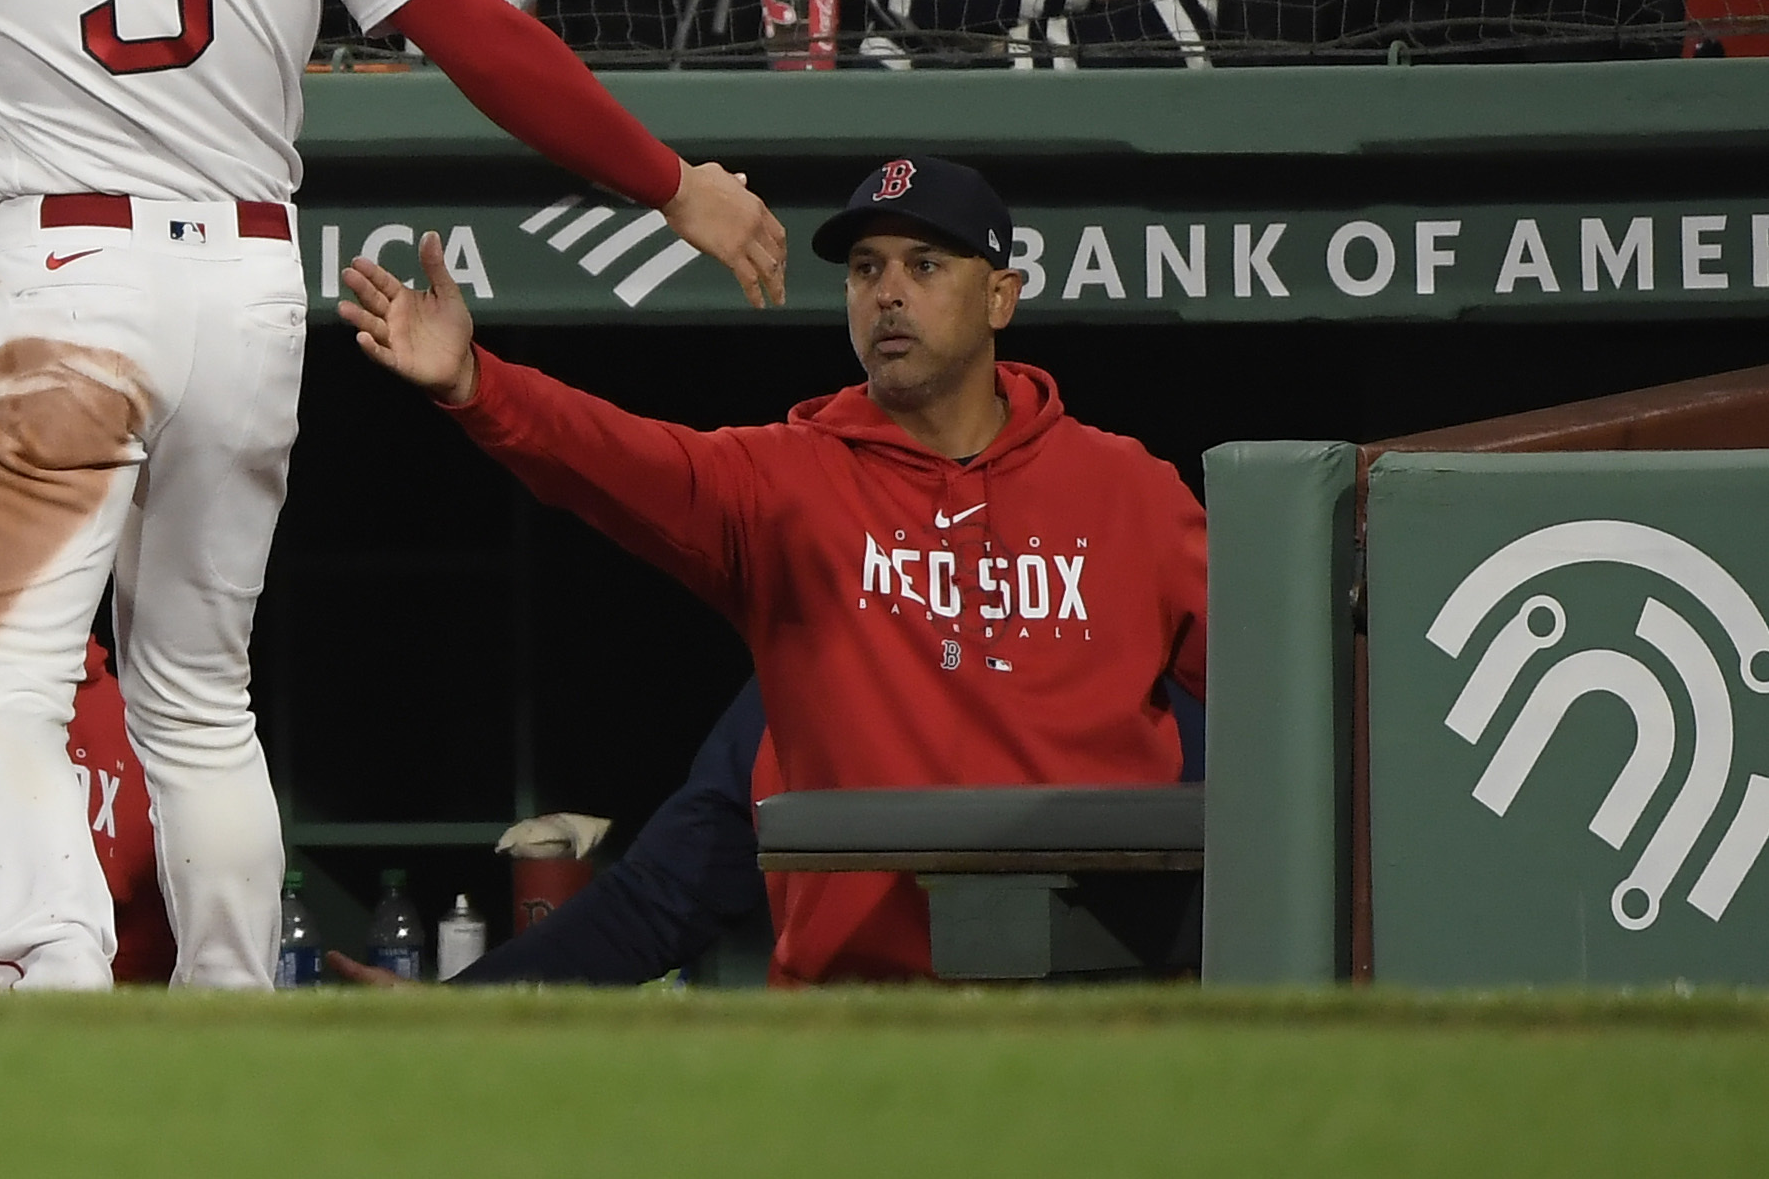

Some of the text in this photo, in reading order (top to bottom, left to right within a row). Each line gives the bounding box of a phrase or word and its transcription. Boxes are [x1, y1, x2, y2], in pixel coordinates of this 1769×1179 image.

[872, 159, 917, 201] B
[1009, 223, 1291, 299] BANK
[1326, 220, 1462, 297] OF
[978, 554, 1088, 621] SOX
[940, 639, 961, 669] B
